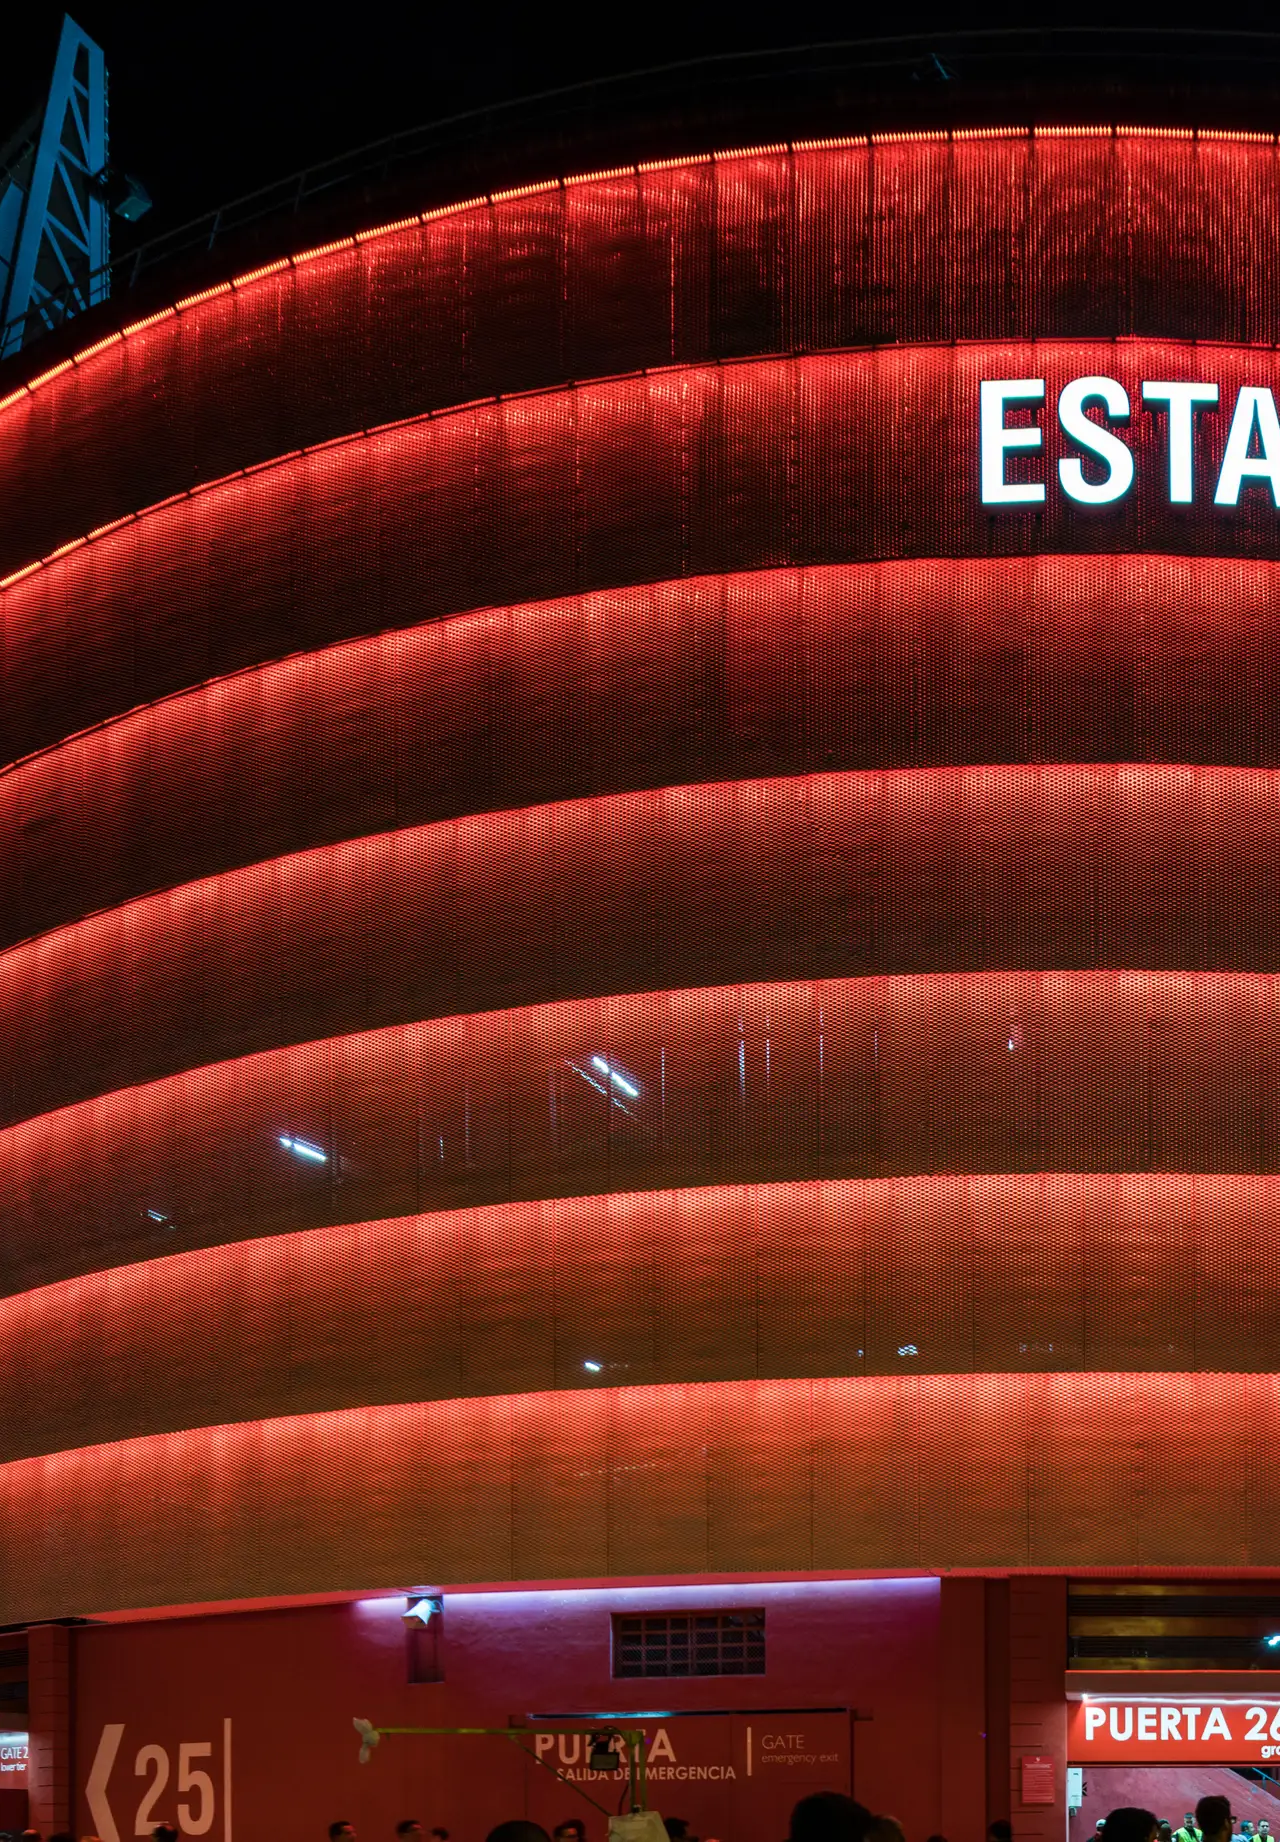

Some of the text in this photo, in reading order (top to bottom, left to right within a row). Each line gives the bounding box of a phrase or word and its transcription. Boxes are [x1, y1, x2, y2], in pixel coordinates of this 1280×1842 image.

[1085, 1707, 1232, 1741] PUERTA
[762, 1735, 805, 1750] GATE
[0, 1747, 21, 1760] GATE
[761, 1751, 839, 1766] emergency exit
[557, 1767, 608, 1781] SALIDA
[135, 1742, 215, 1836] 25
